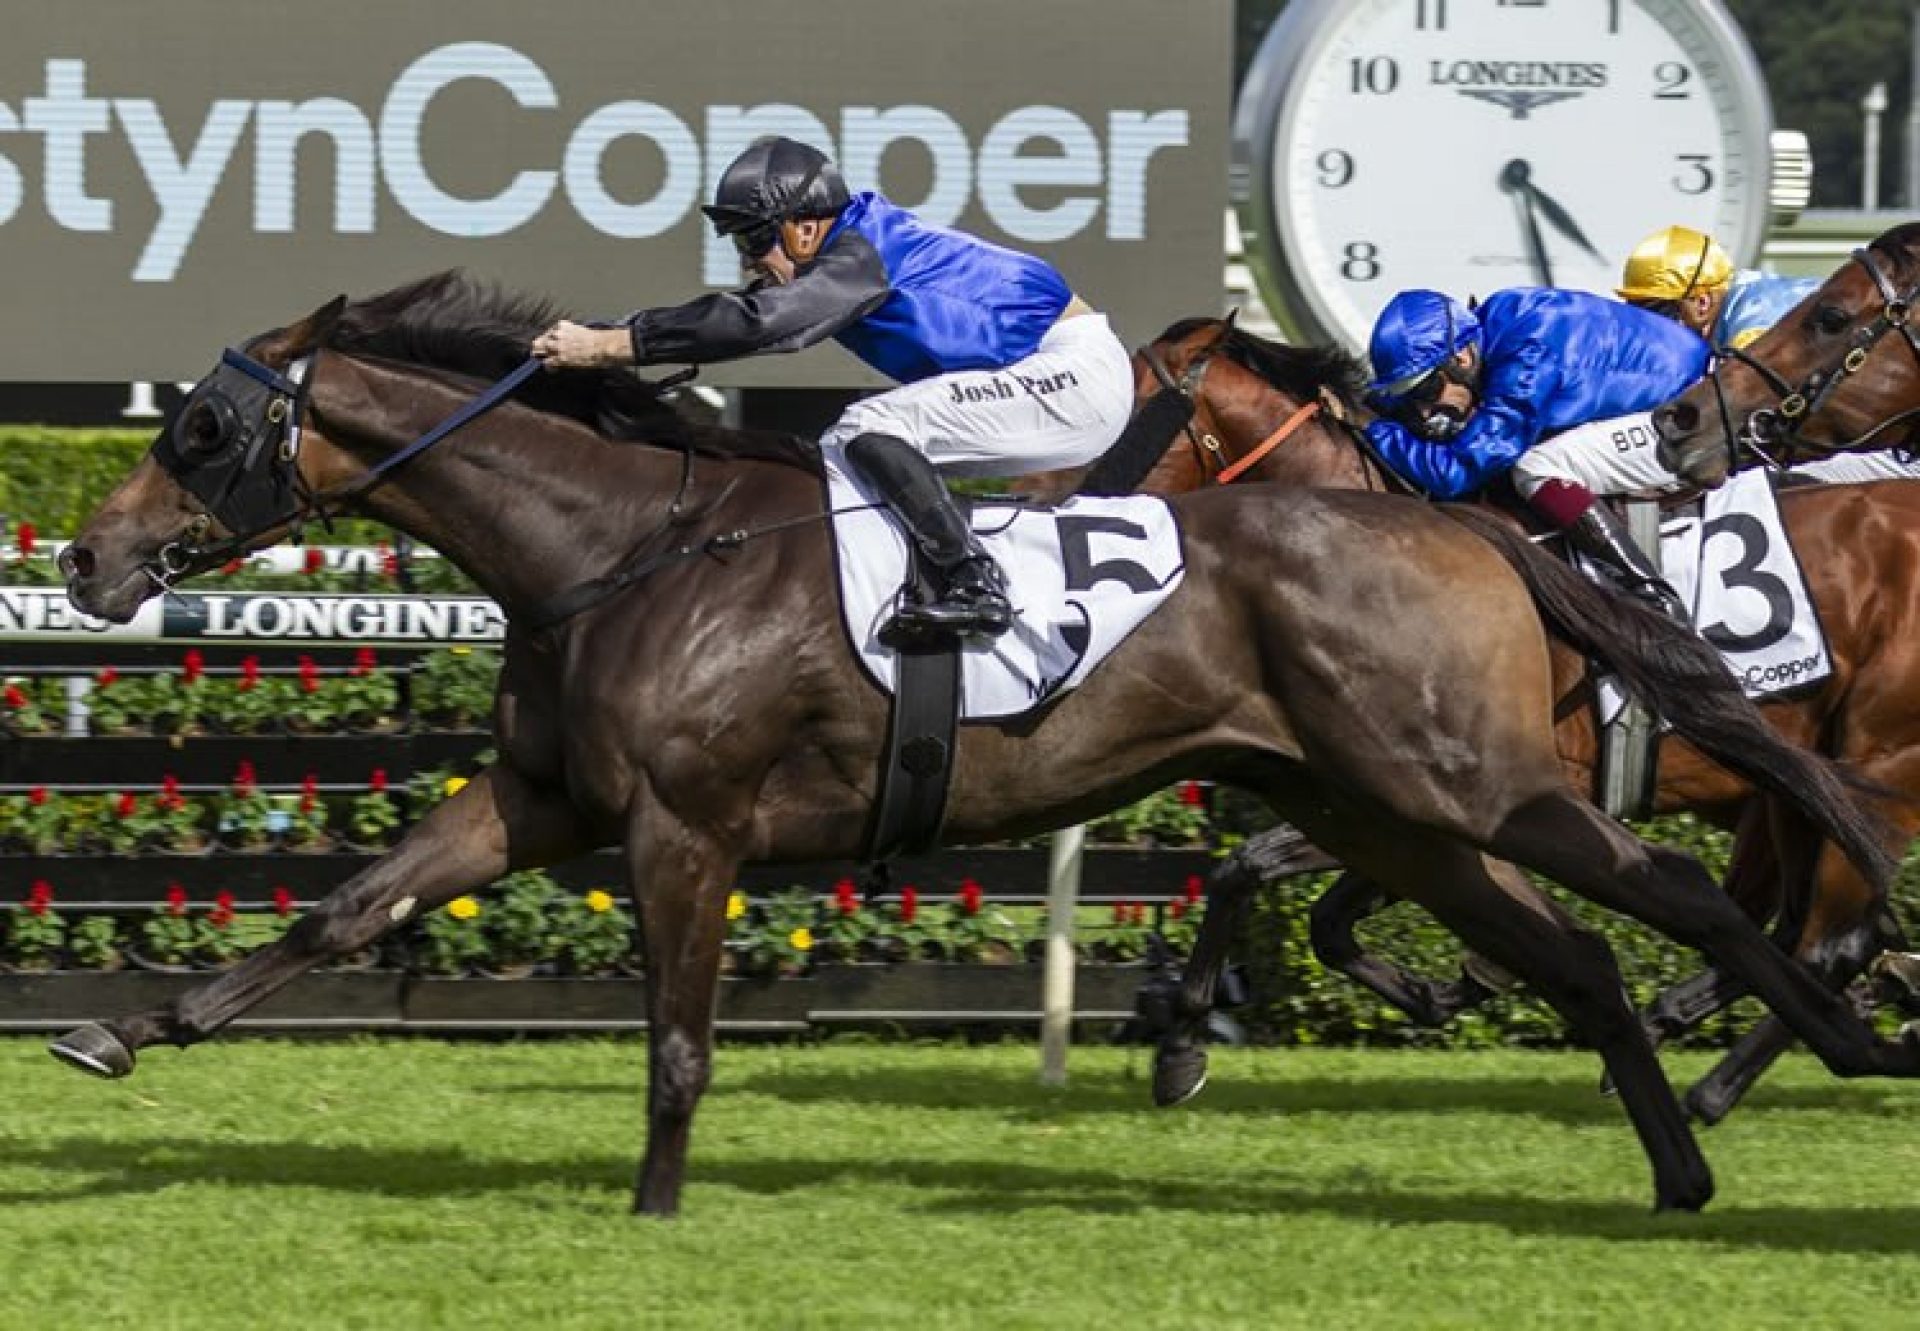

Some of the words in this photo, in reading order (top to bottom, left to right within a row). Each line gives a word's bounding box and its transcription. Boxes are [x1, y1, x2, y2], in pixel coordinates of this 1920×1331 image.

[1351, 56, 1398, 95] 10
[1430, 60, 1607, 87] LONGINES
[1652, 61, 1691, 99] 2
[0, 41, 1189, 286] tynCopper
[1316, 148, 1356, 188] 9
[1672, 155, 1714, 195] 3
[1340, 241, 1381, 282] 8
[949, 376, 1014, 404] Josh
[1055, 516, 1163, 594] 5
[1701, 513, 1795, 653] 3
[0, 593, 111, 633] NE
[201, 595, 505, 638] LONGINE
[1740, 655, 1820, 690] Copper
